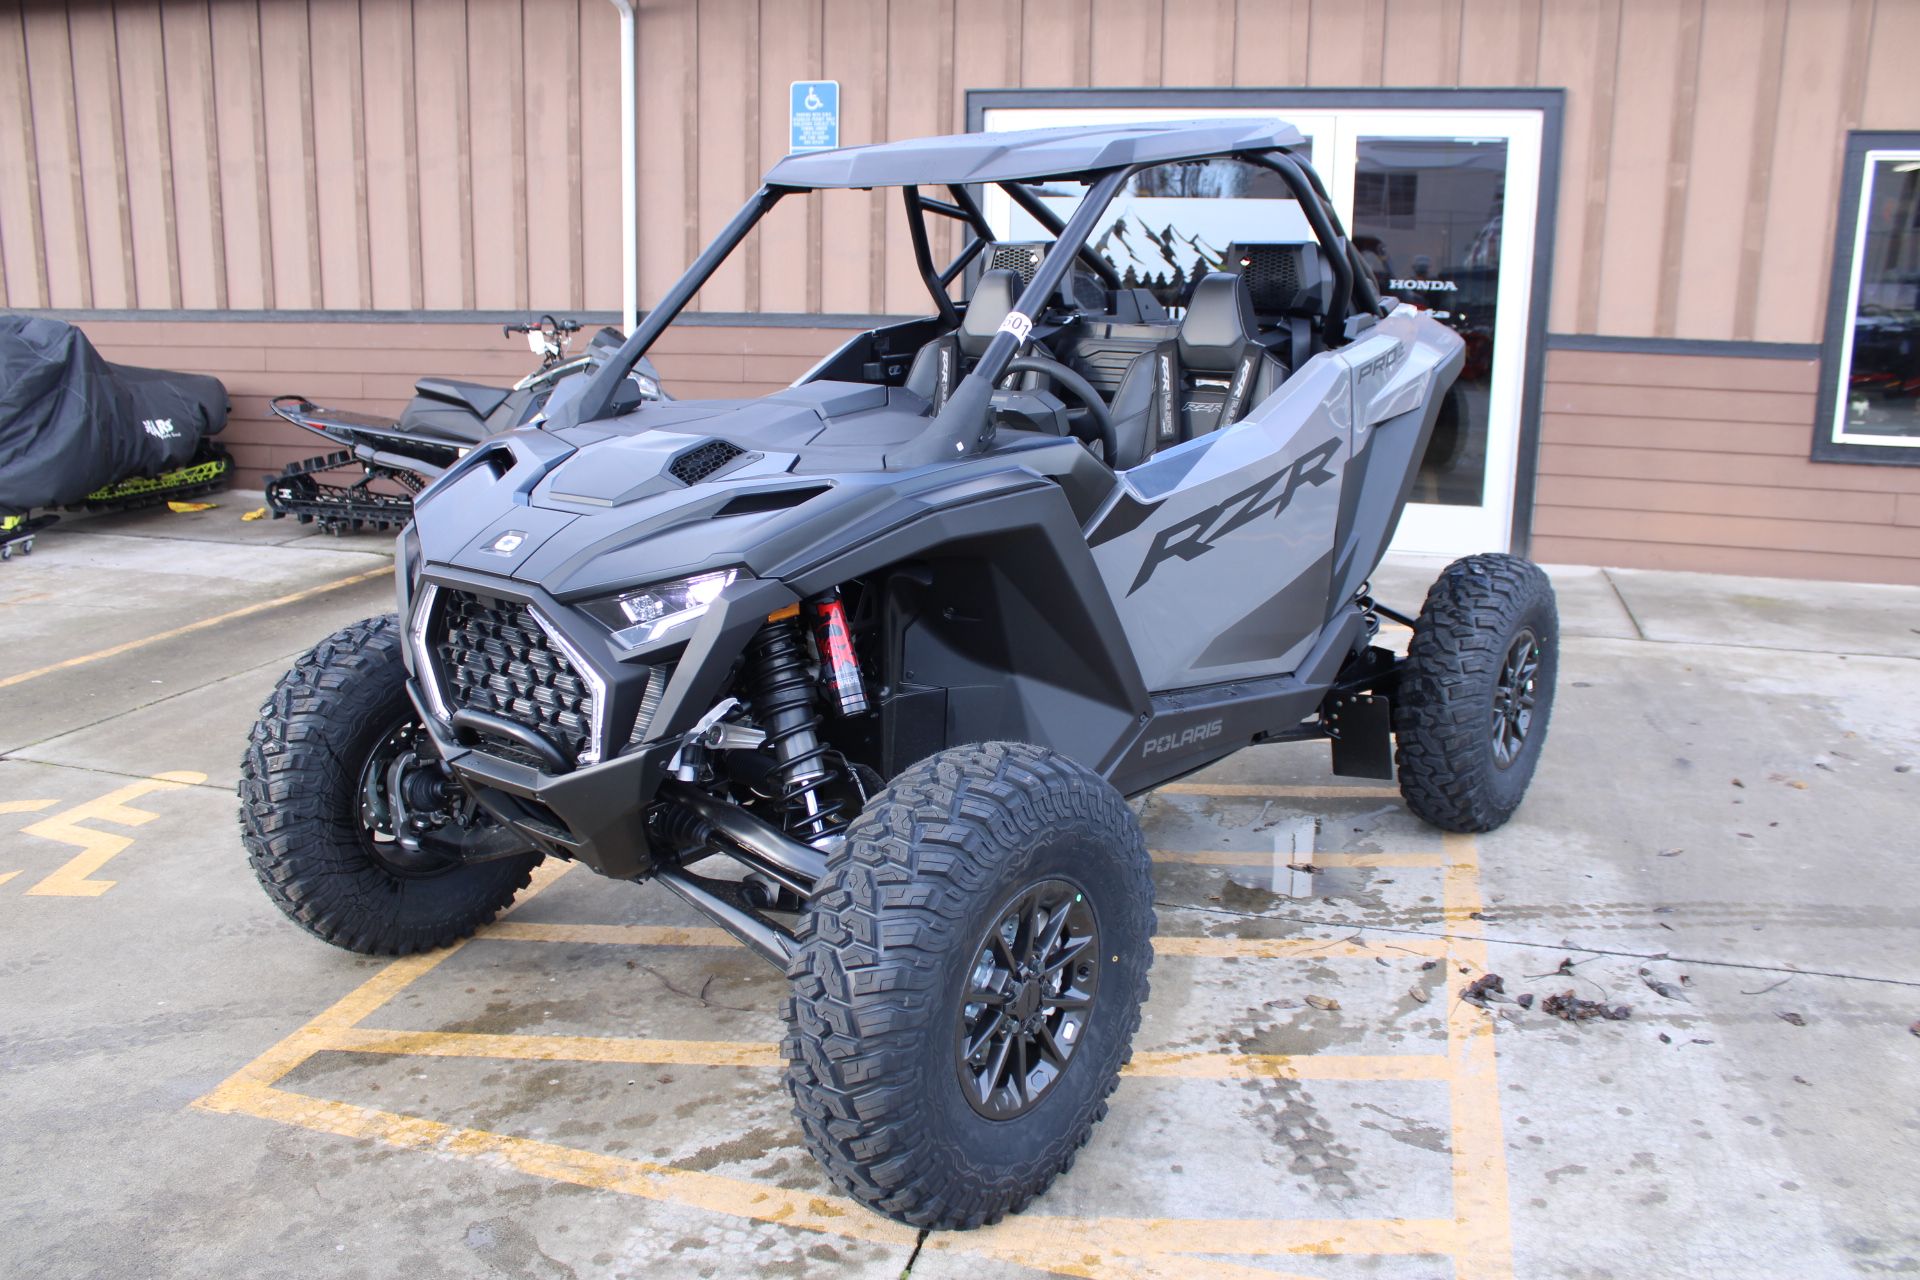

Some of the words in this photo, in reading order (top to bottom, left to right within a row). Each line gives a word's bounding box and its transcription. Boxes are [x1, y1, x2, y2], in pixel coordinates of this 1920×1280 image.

[1389, 279, 1458, 291] HONDA
[1125, 436, 1343, 599] RZR
[1142, 720, 1223, 758] POLARIS
